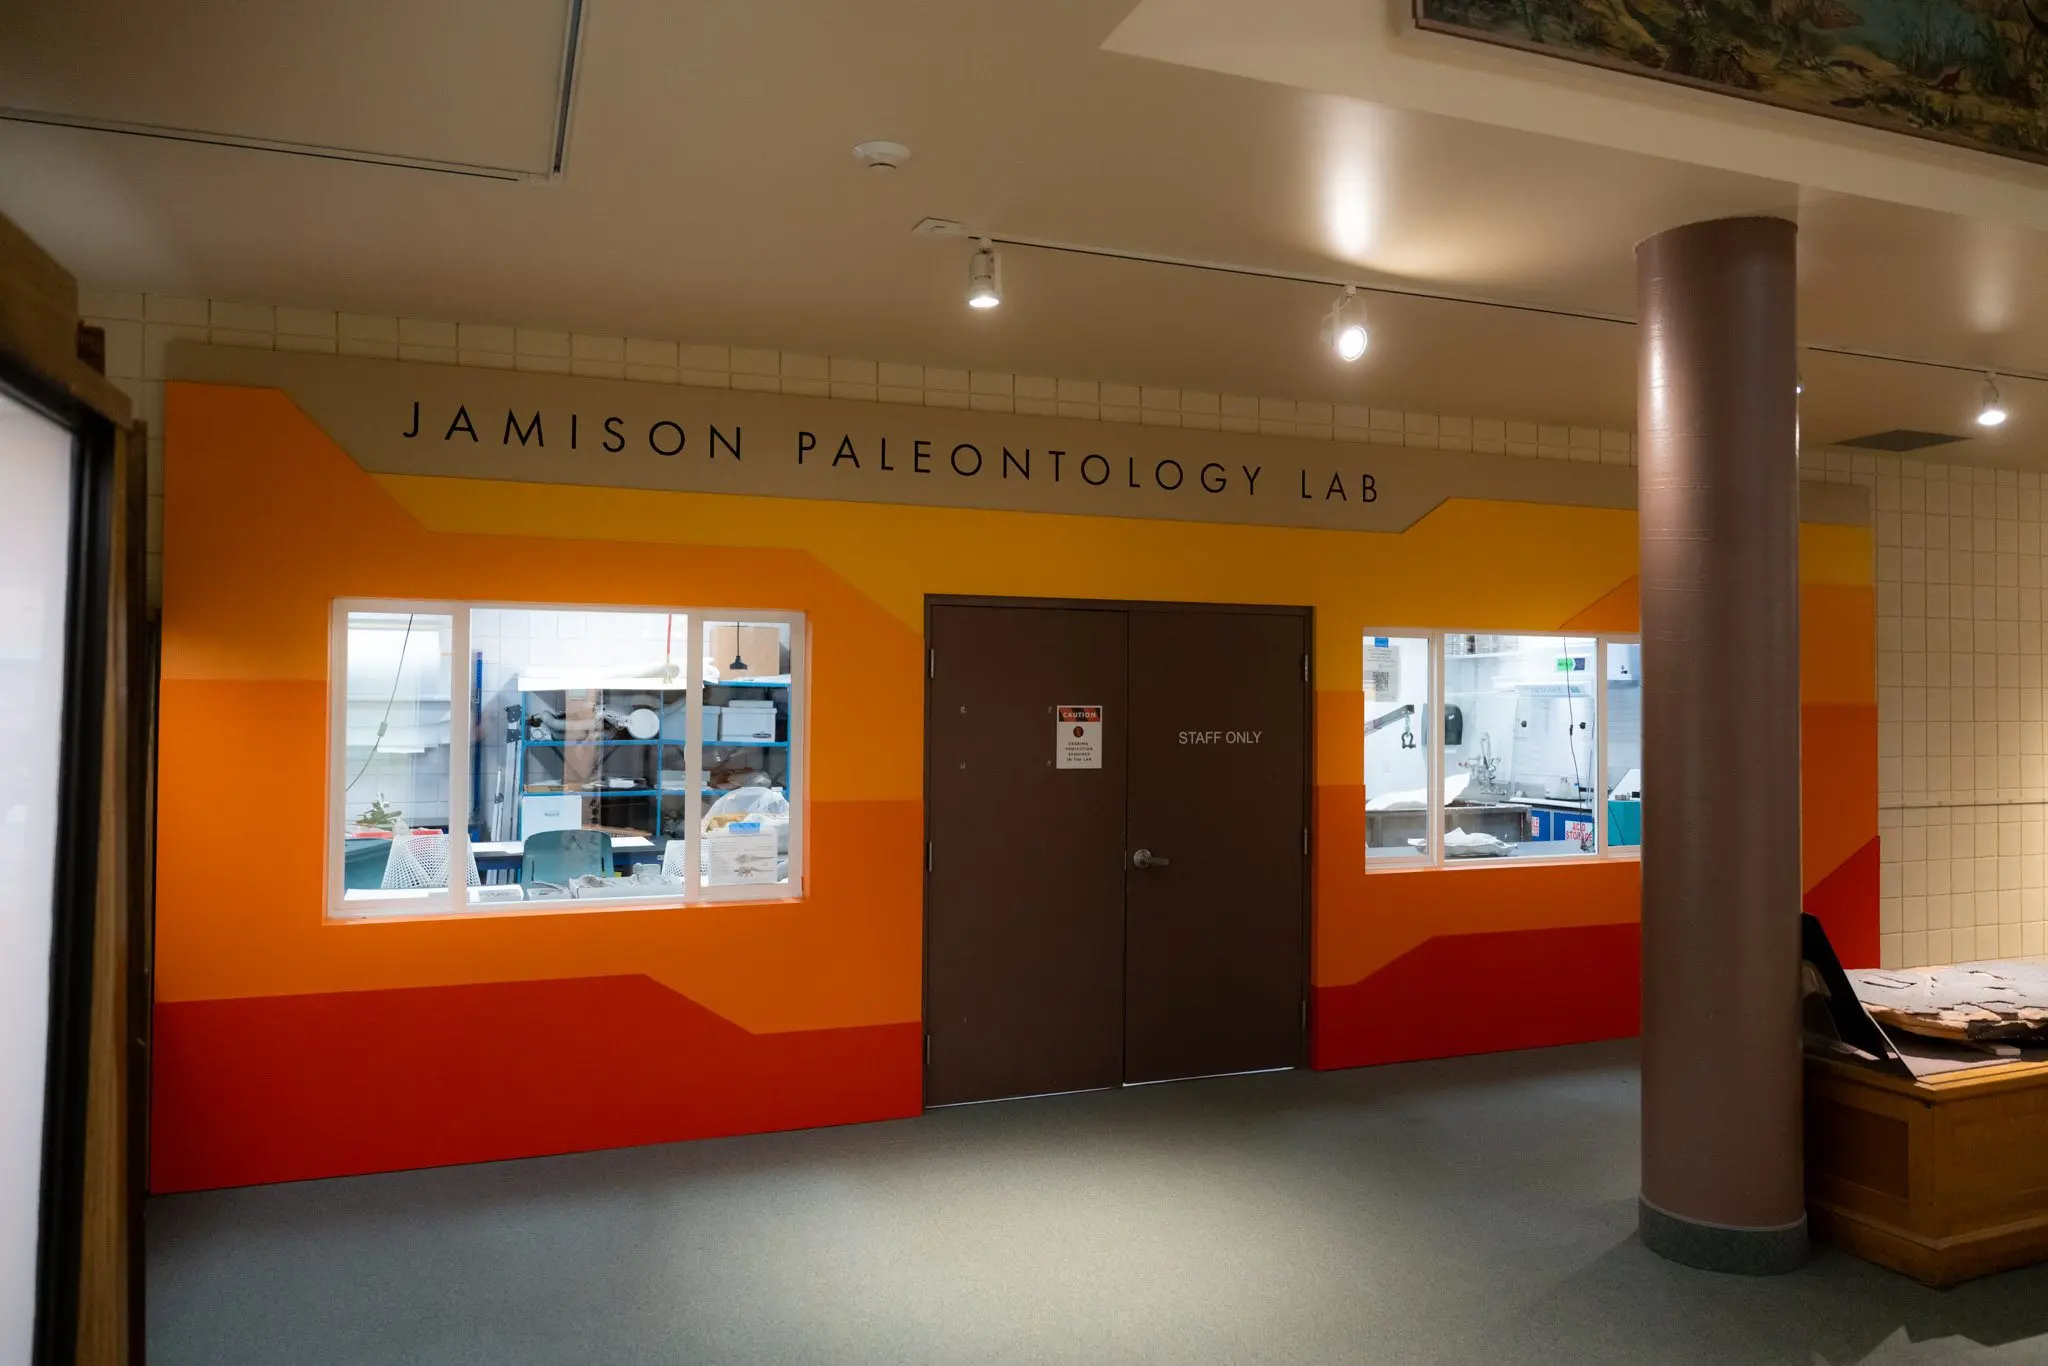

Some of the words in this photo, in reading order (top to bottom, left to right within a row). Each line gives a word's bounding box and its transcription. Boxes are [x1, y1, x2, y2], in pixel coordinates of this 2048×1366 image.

[402, 401, 741, 461] JAMISON
[798, 431, 1262, 496] PALEONTOLOGY
[1301, 469, 1378, 503] LAB
[1178, 731, 1222, 744] STAFF
[1225, 731, 1262, 744] ONLY
